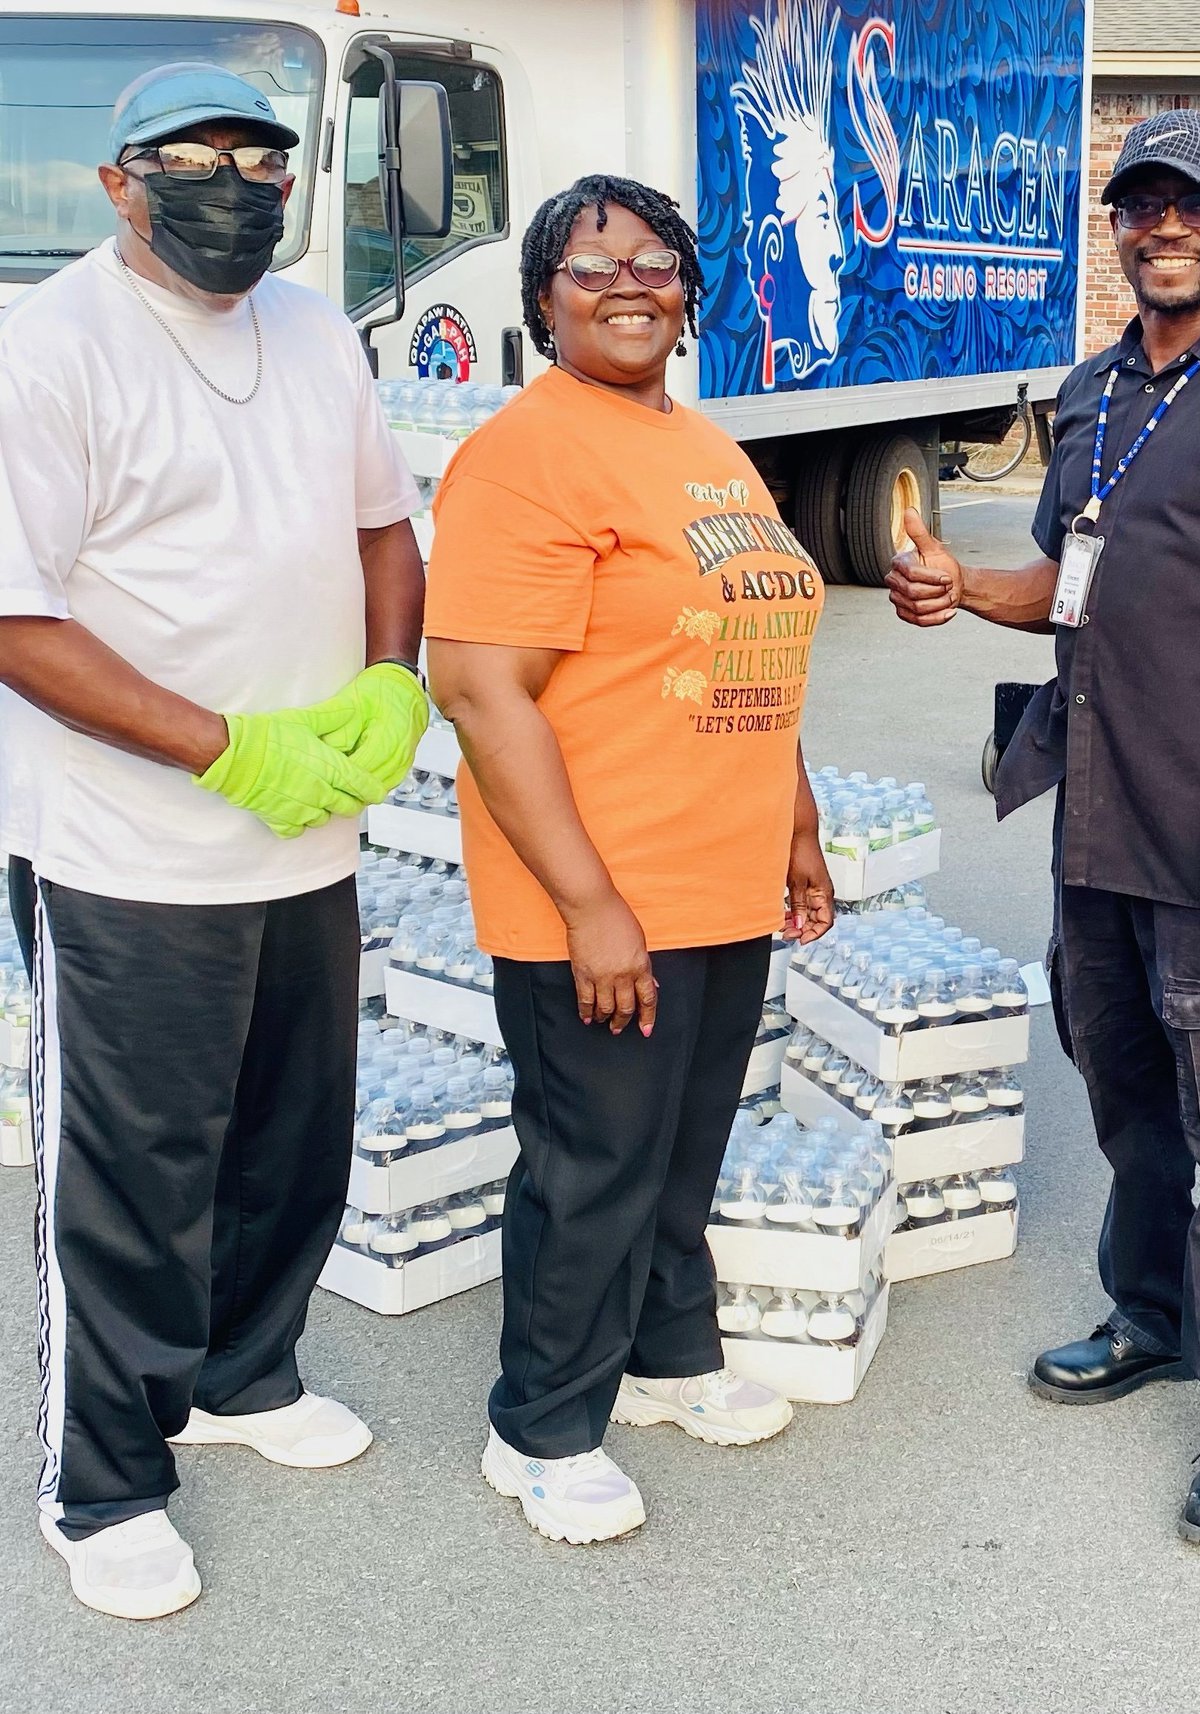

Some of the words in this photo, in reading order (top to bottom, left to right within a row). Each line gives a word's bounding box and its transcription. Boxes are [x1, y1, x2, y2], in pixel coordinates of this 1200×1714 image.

[848, 17, 1066, 247] SARACEN
[904, 263, 977, 301] CASINO
[985, 266, 1049, 301] RESORT
[410, 306, 444, 364] QUAPAW
[446, 307, 476, 362] NATION
[685, 482, 728, 507] City
[728, 479, 750, 507] Of
[721, 573, 737, 602] &
[718, 612, 758, 641] 11th
[710, 649, 756, 682] FALL
[760, 645, 811, 681] FESTIVAL
[712, 686, 783, 709] SEPTEMBER
[737, 714, 773, 733] COME
